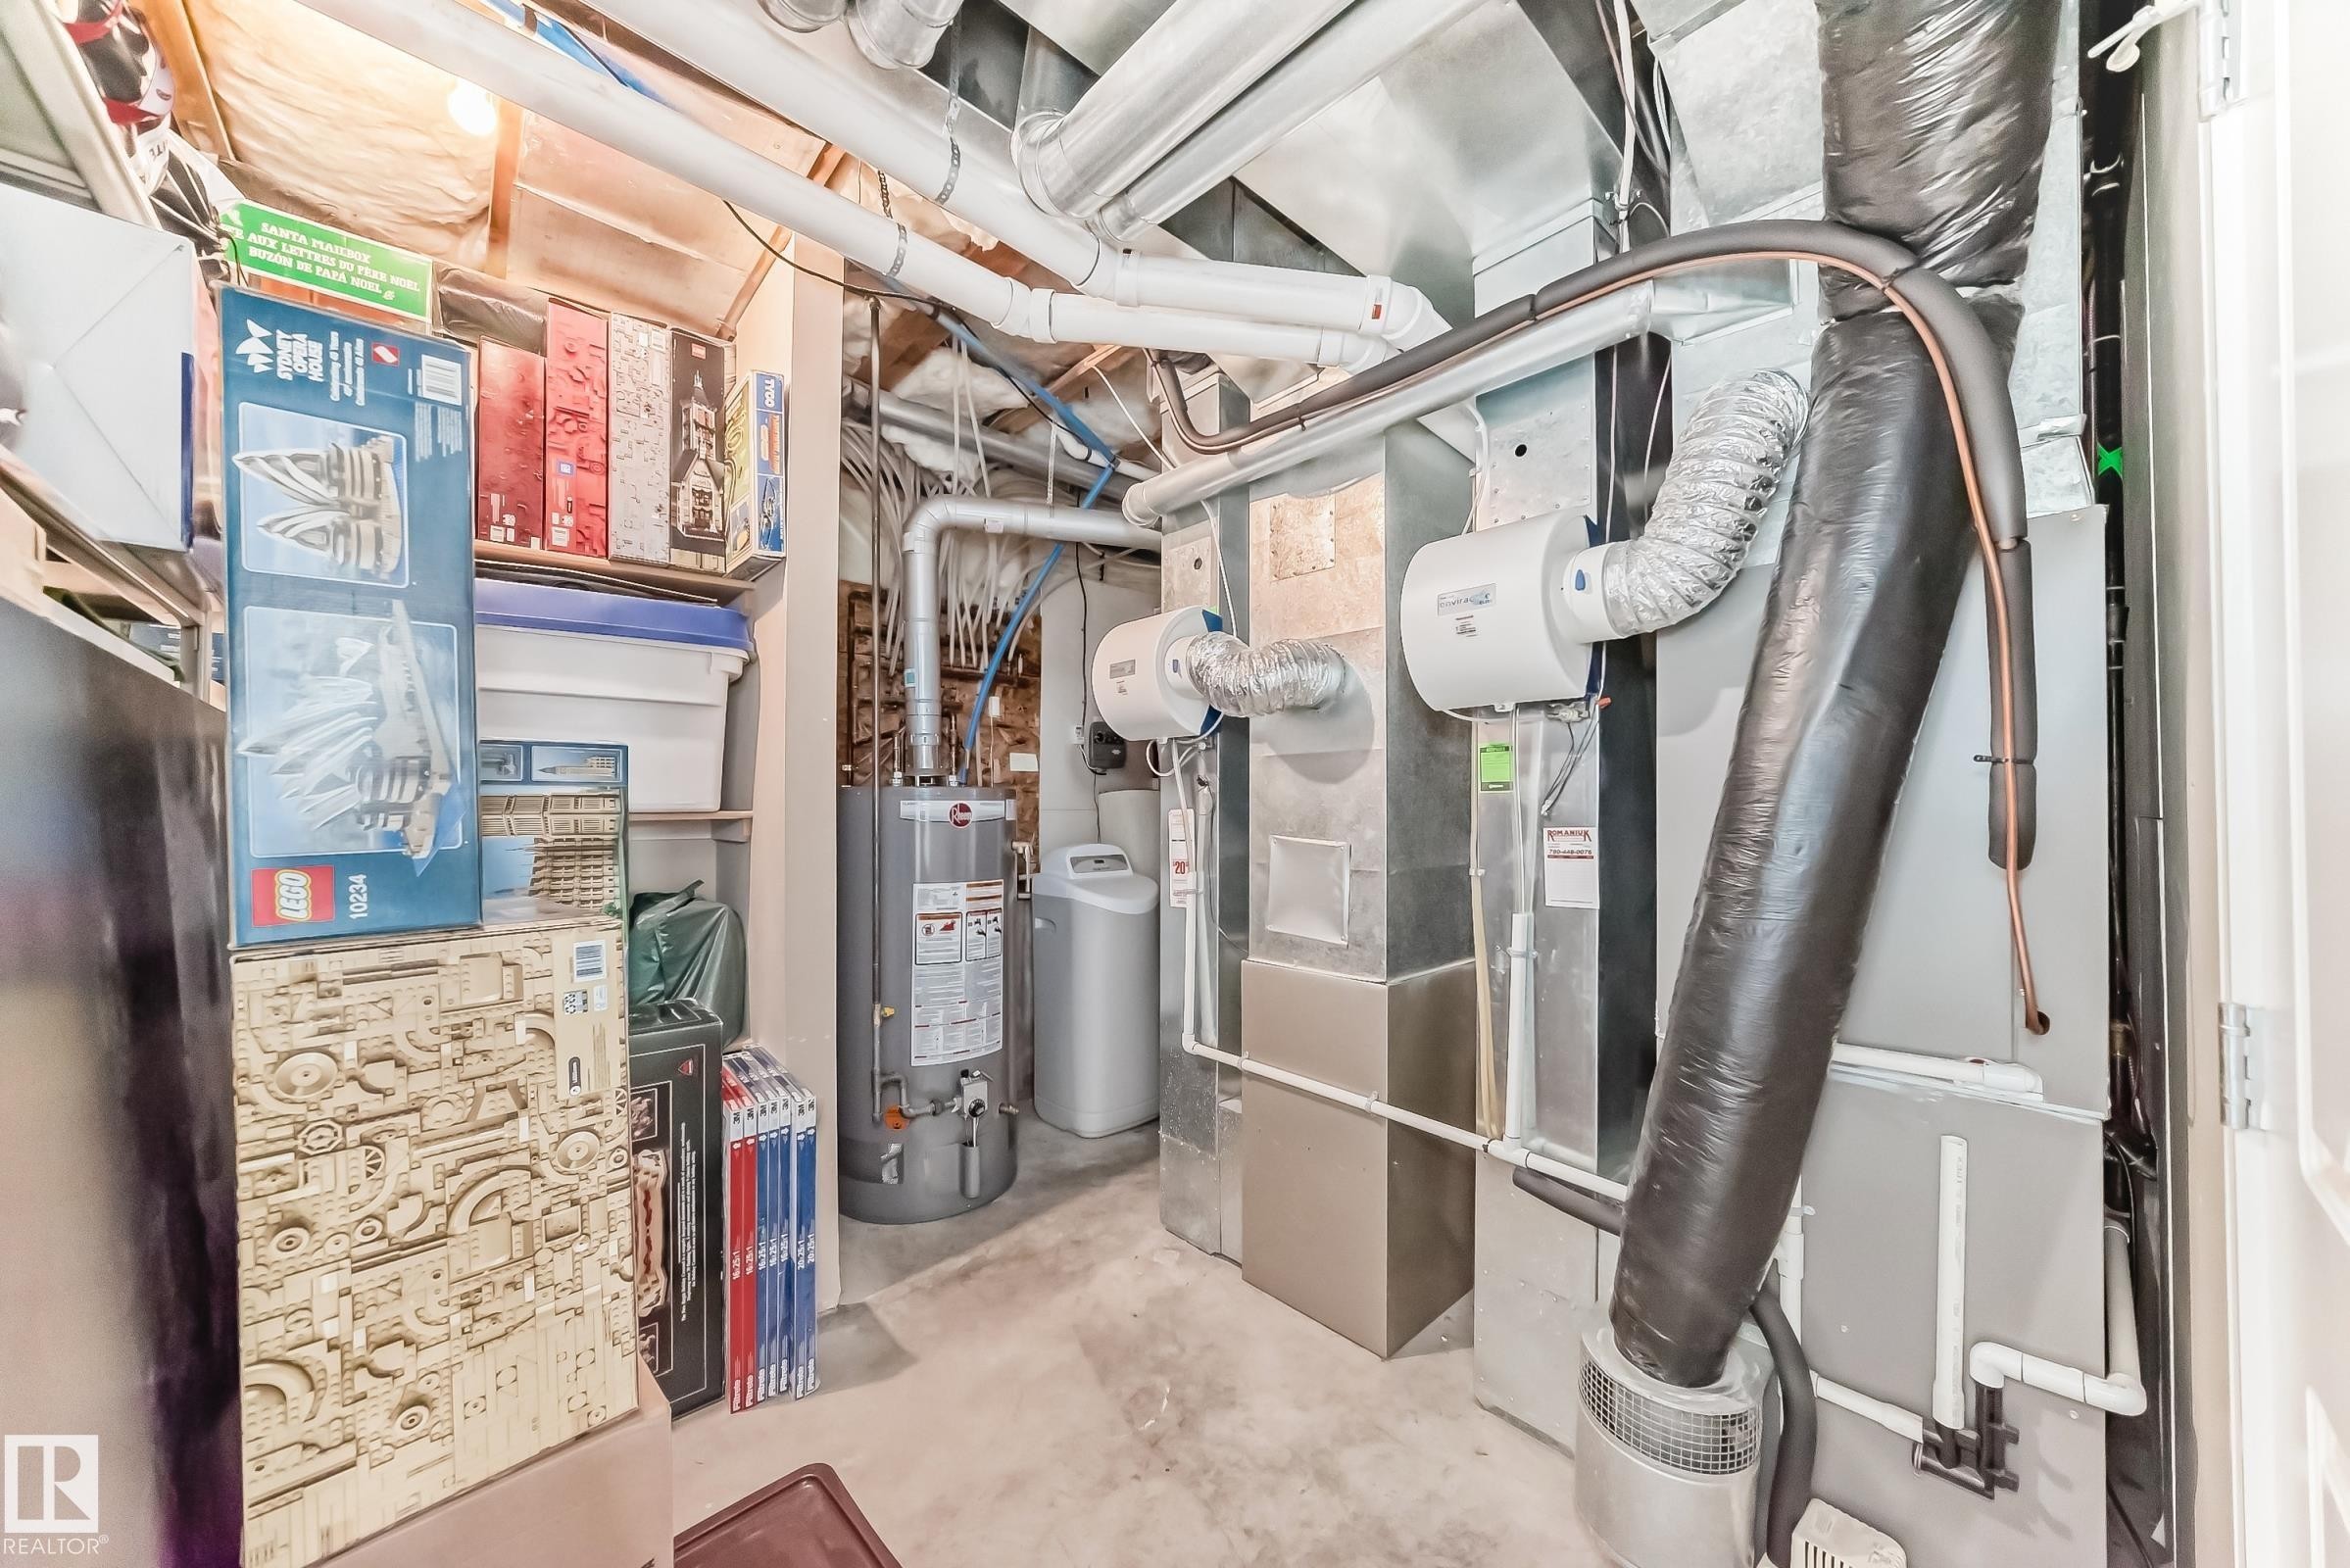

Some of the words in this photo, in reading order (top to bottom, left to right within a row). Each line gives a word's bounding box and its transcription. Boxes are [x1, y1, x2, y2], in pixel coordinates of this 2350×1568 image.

[248, 232, 278, 250] AUX
[281, 242, 337, 267] LETTRES
[339, 259, 354, 271] DU
[262, 222, 308, 245] SANTA
[312, 237, 371, 265] MAILBOX
[249, 246, 292, 269] BUZÓN
[297, 261, 313, 273] DE
[351, 277, 382, 294] NOEL
[276, 329, 293, 381] SYDNEY
[292, 333, 308, 373] OPERA
[308, 340, 324, 382] HOUSE
[764, 378, 775, 408] TYCO
[1547, 830, 1591, 842] ROMANIUK
[278, 872, 309, 920] LEGO
[349, 874, 368, 920] 10234
[733, 1111, 741, 1125] 3M
[747, 1107, 755, 1121] 3M
[759, 1103, 767, 1117] 3M
[770, 1102, 777, 1114] 3M
[798, 1103, 805, 1117] 3M
